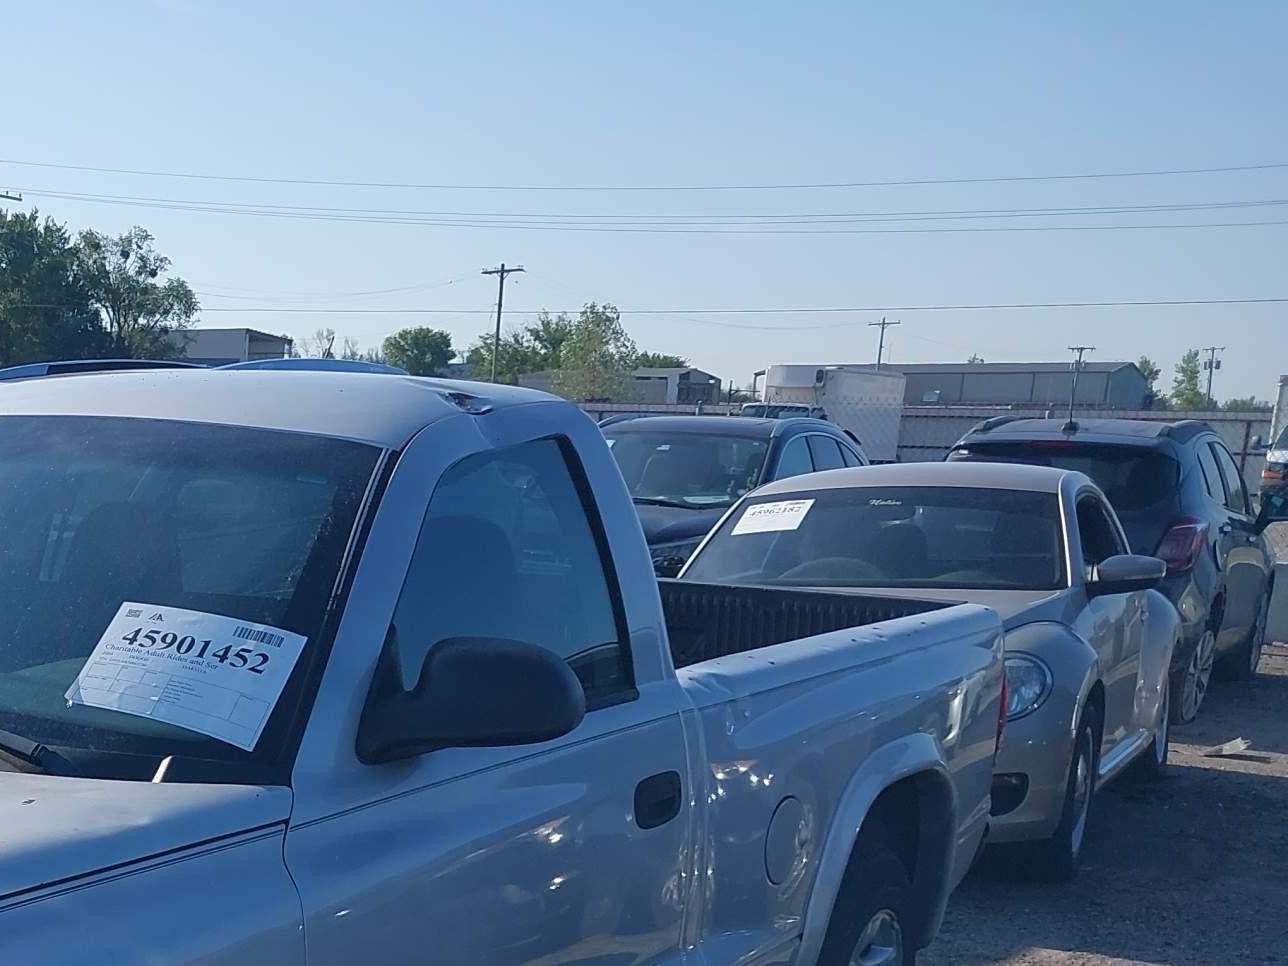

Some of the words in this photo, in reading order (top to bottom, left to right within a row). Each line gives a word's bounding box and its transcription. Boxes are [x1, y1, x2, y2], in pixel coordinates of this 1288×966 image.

[105, 643, 143, 655] Charitable
[144, 649, 165, 658] Adult
[167, 653, 189, 663] Rides
[189, 658, 204, 667] and
[122, 627, 270, 675] 45901452
